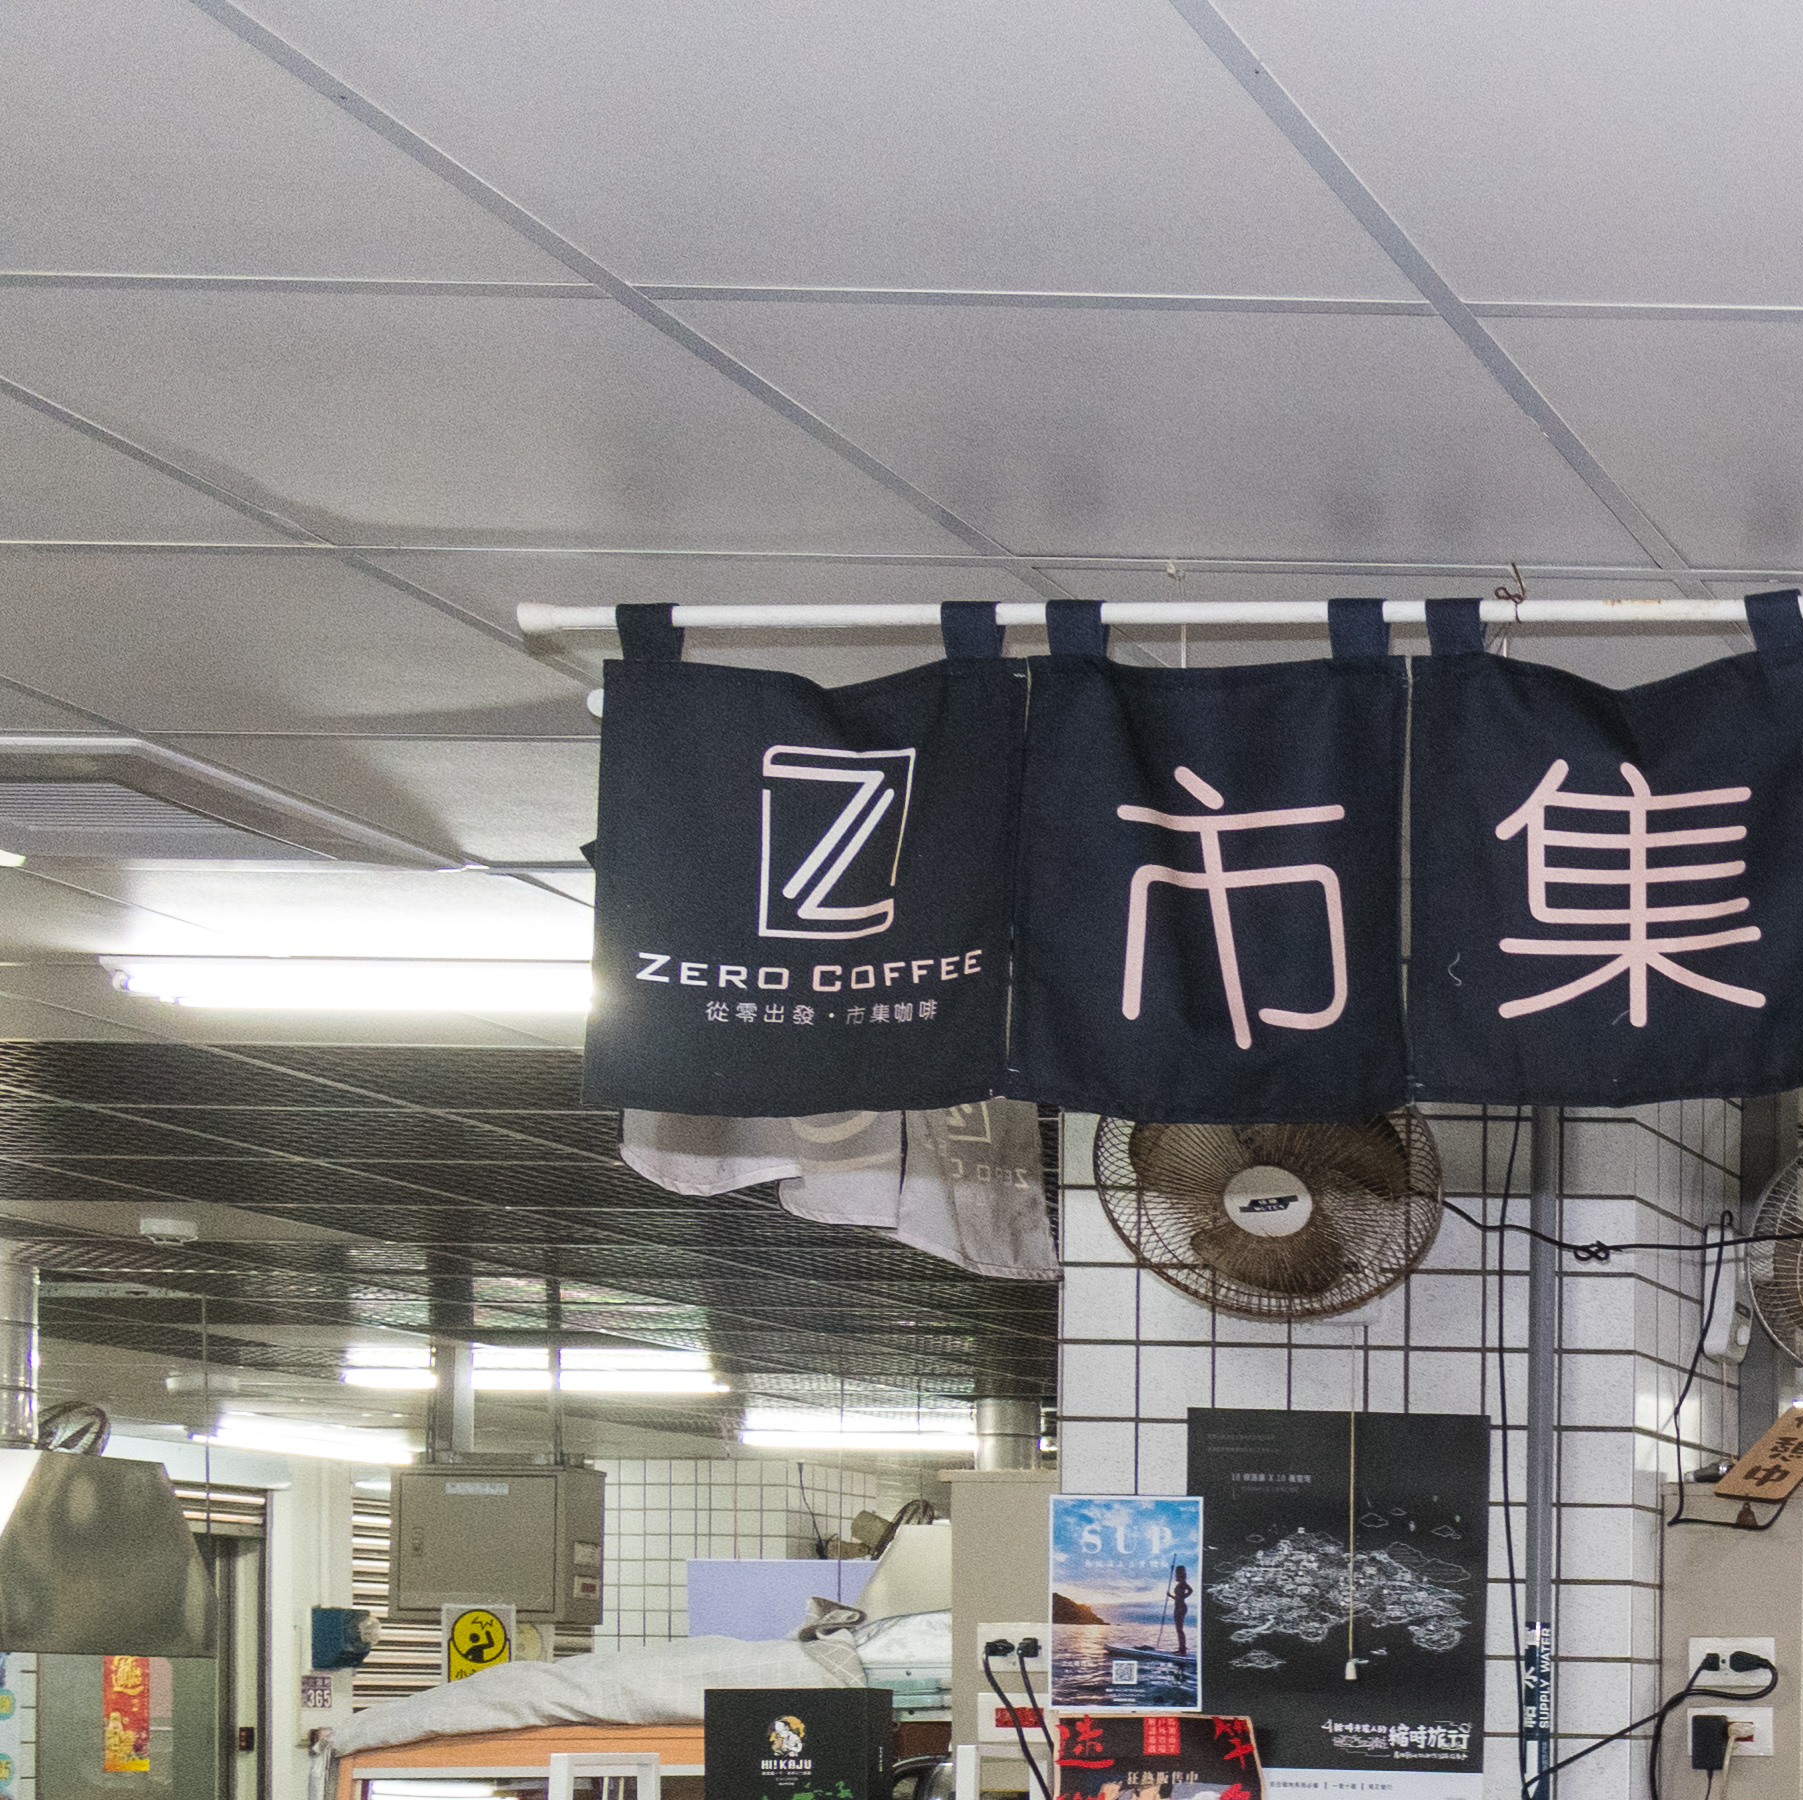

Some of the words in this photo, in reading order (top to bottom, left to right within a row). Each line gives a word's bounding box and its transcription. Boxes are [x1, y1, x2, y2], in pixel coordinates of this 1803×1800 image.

[635, 951, 790, 991] ZERO
[811, 949, 983, 992] COFFEE
[1082, 1524, 1173, 1555] SUP
[1540, 1627, 1552, 1674] WATER
[1538, 1679, 1551, 1730] SUPPLY
